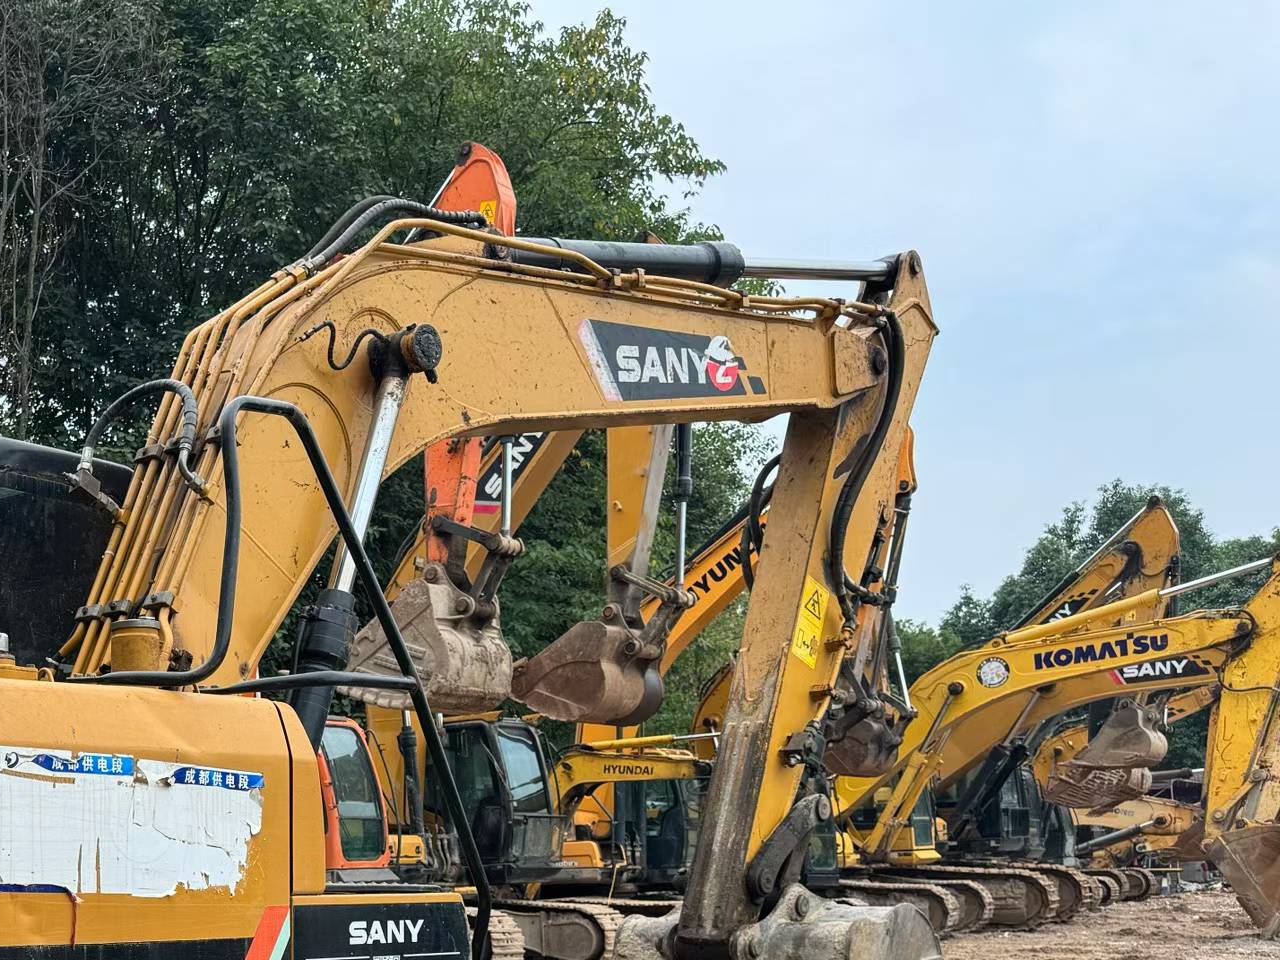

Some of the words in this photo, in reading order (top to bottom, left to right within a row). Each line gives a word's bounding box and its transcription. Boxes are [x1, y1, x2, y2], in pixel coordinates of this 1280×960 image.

[615, 345, 710, 384] SANY
[1034, 632, 1168, 670] KOMATSU
[1122, 659, 1189, 679] SANY
[184, 768, 249, 789] 成都供电段
[603, 764, 654, 776] HYUNDAI
[349, 919, 425, 945] SANY
